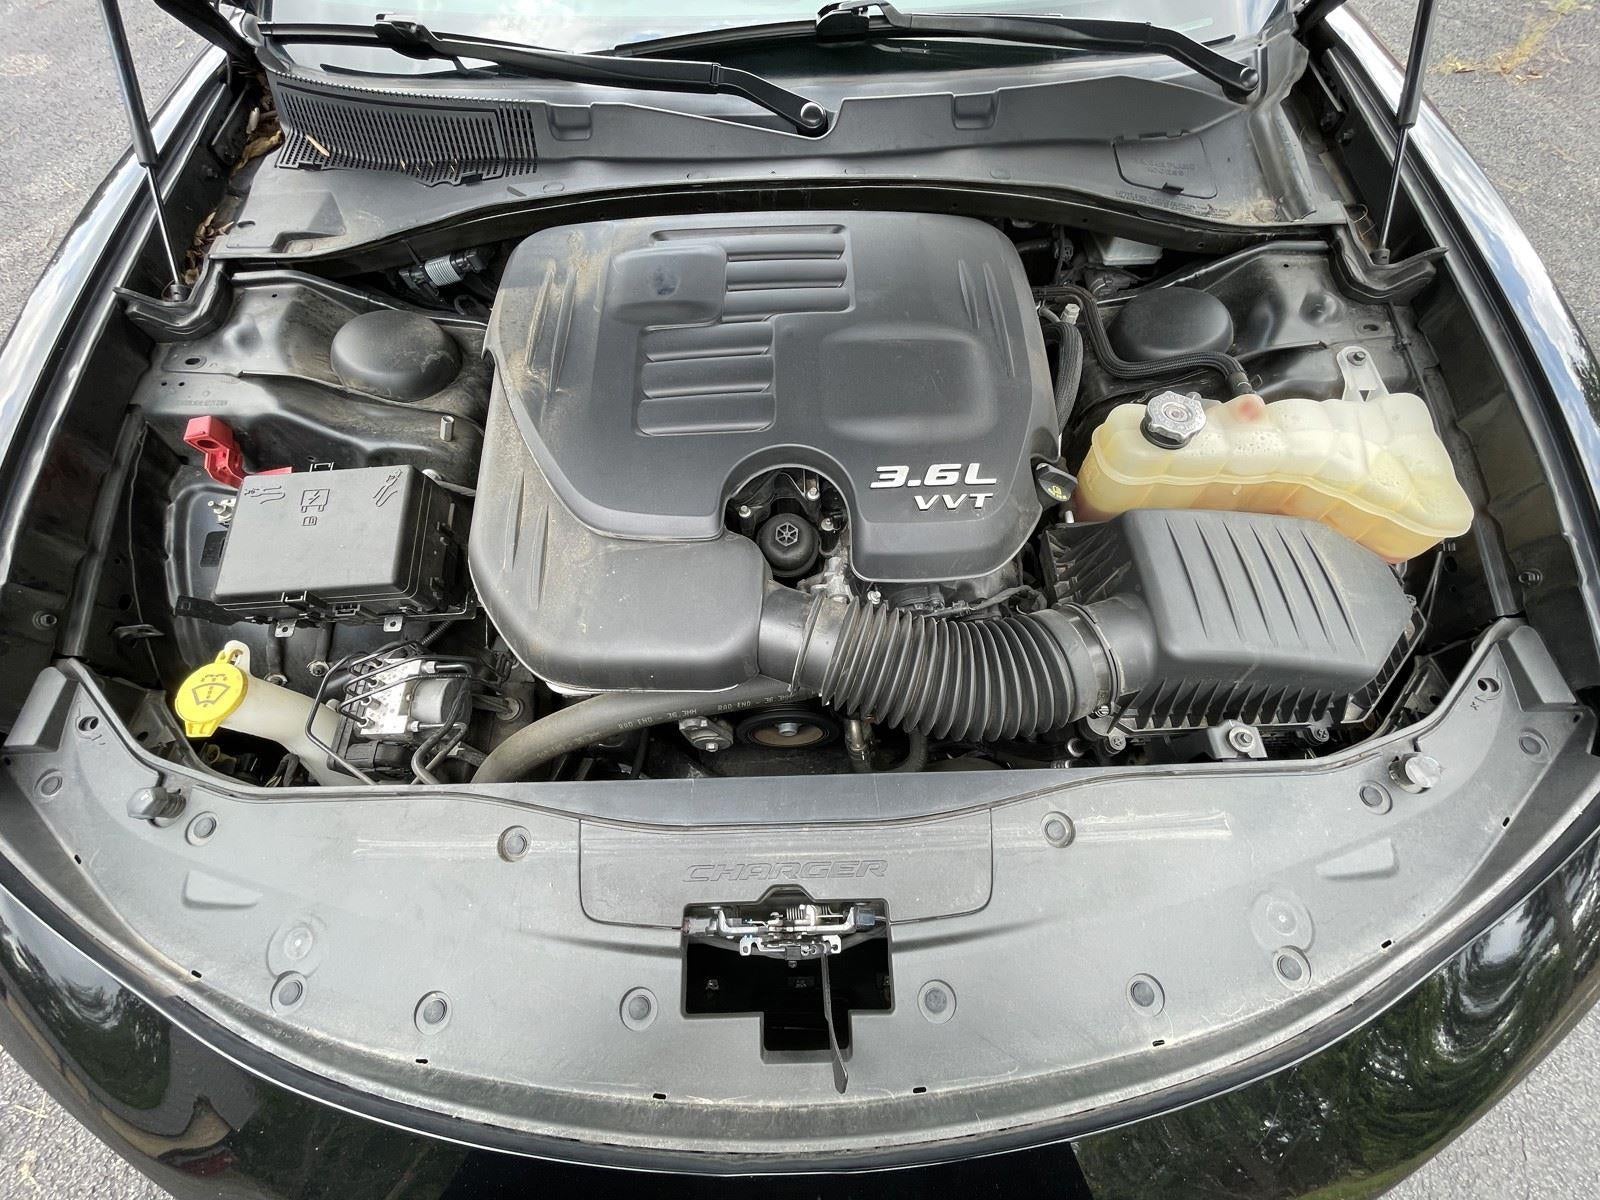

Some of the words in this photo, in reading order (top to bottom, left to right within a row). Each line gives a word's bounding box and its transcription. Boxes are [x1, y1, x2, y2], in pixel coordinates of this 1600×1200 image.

[870, 463, 997, 488] 3.6L
[914, 493, 994, 511] VVT
[683, 860, 889, 882] CHARGER
